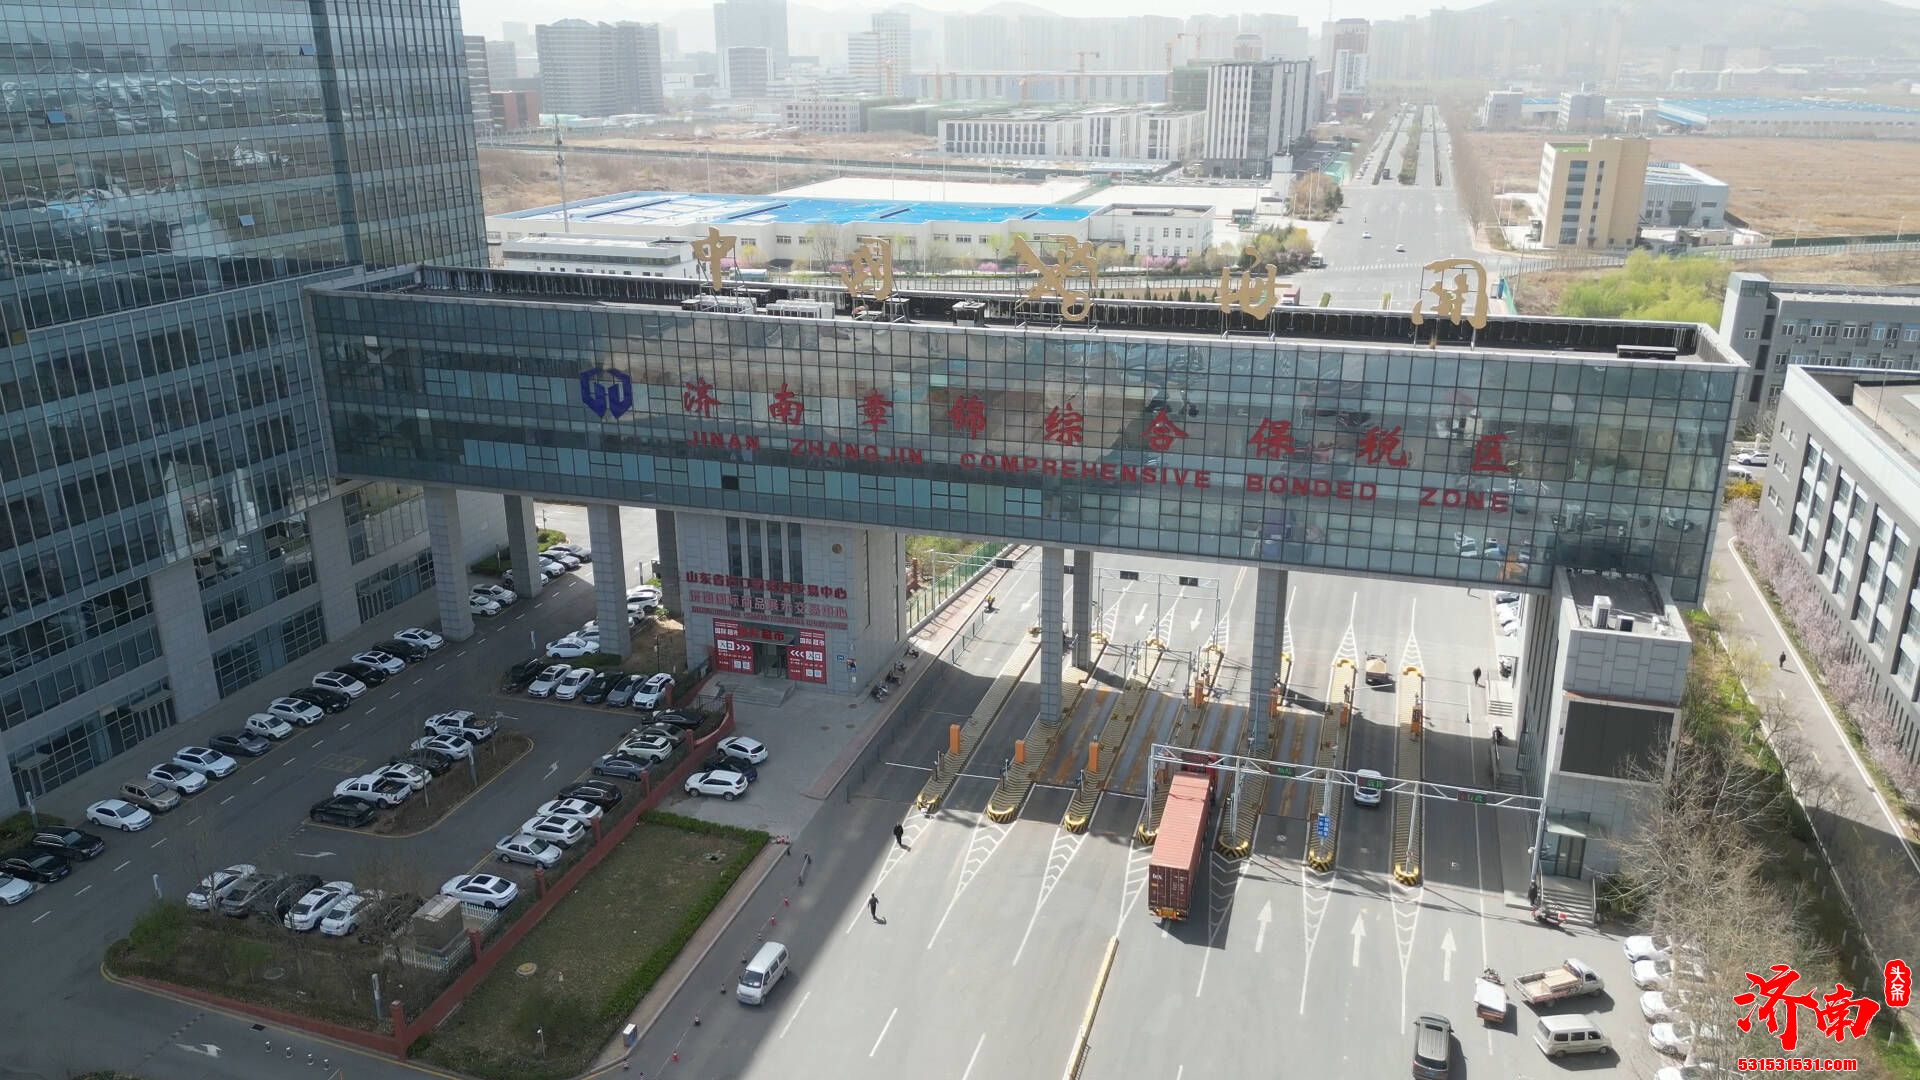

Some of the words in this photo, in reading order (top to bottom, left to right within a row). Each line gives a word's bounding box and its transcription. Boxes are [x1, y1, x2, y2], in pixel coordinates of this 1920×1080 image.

[684, 377, 1510, 473] 济南章锦综合保税区
[687, 431, 761, 451] JINAN
[790, 438, 923, 465] ZHANGJIN
[959, 452, 1213, 490] COMPREHENSIVE
[1245, 473, 1378, 501] BONDED
[1421, 486, 1511, 514] ZONE
